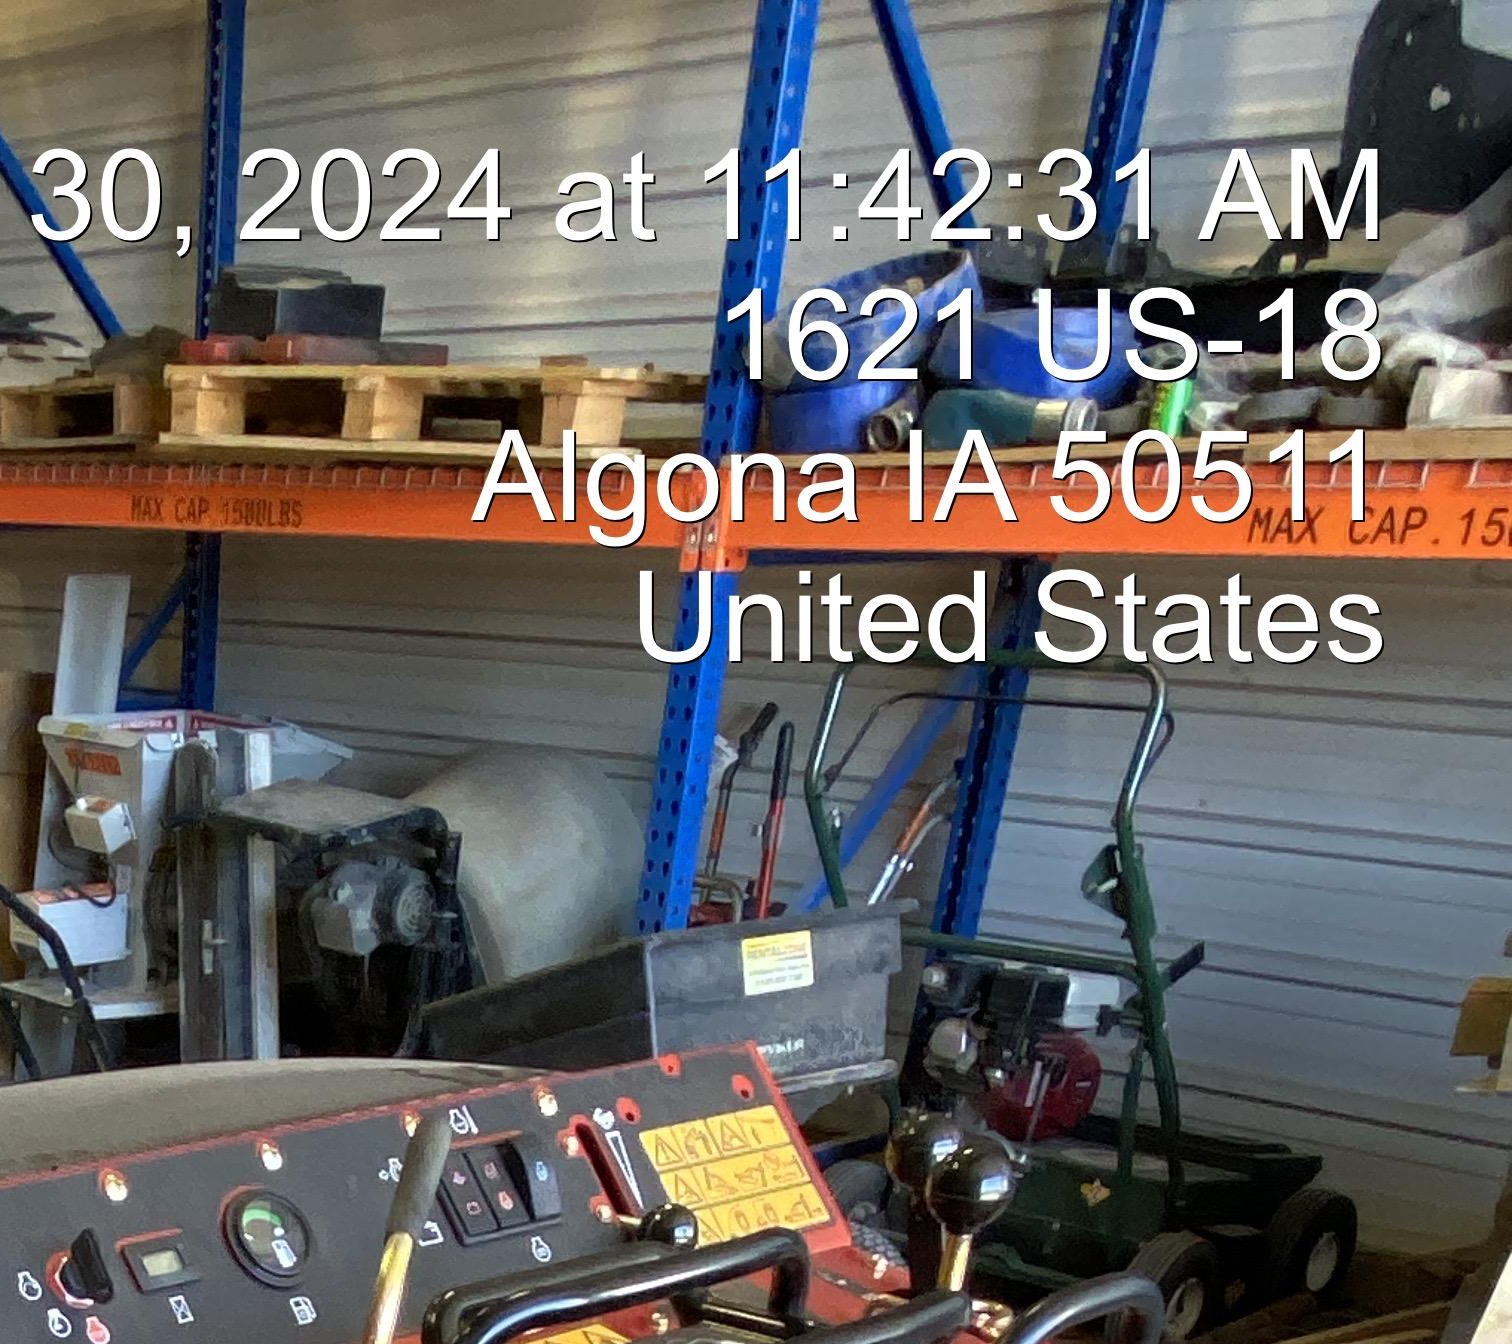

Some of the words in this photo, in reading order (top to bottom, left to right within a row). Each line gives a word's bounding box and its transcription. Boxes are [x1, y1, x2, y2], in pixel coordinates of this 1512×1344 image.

[130, 494, 165, 522] MAX
[1246, 506, 1326, 545] MAX
[1460, 507, 1512, 547] 15
